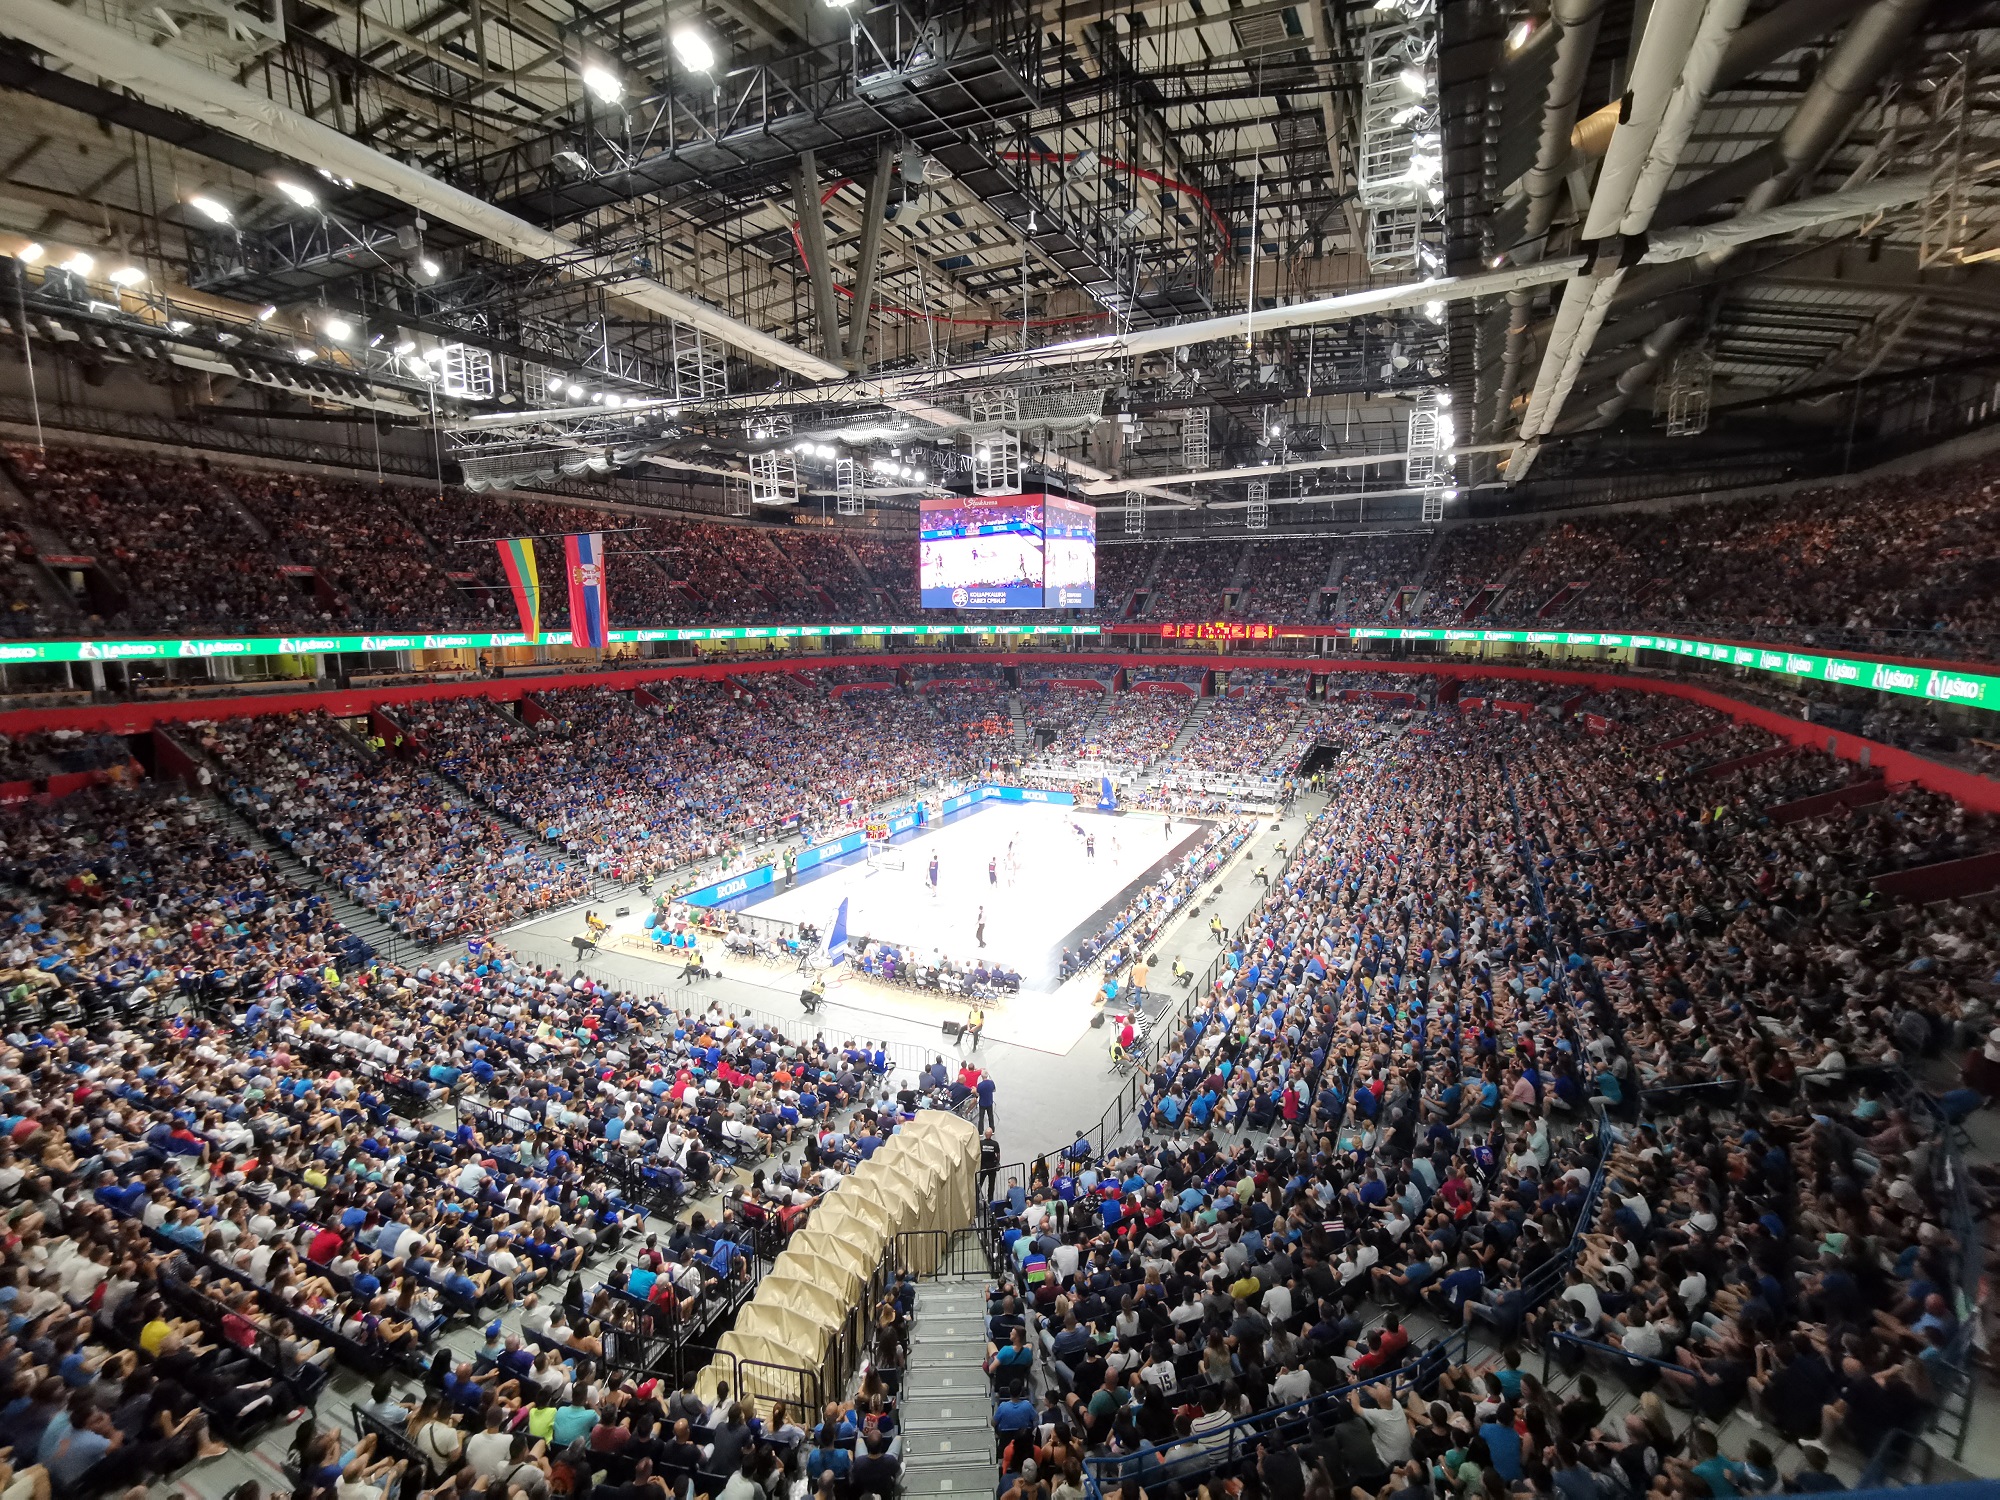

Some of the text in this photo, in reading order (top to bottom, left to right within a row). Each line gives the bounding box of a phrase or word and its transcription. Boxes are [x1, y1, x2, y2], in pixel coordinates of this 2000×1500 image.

[1883, 668, 1914, 690] LAŠKO
[1940, 675, 1979, 699] LAŠKO
[819, 842, 843, 859] RODA
[716, 878, 748, 898] RODA
[1159, 1374, 1172, 1391] 15
